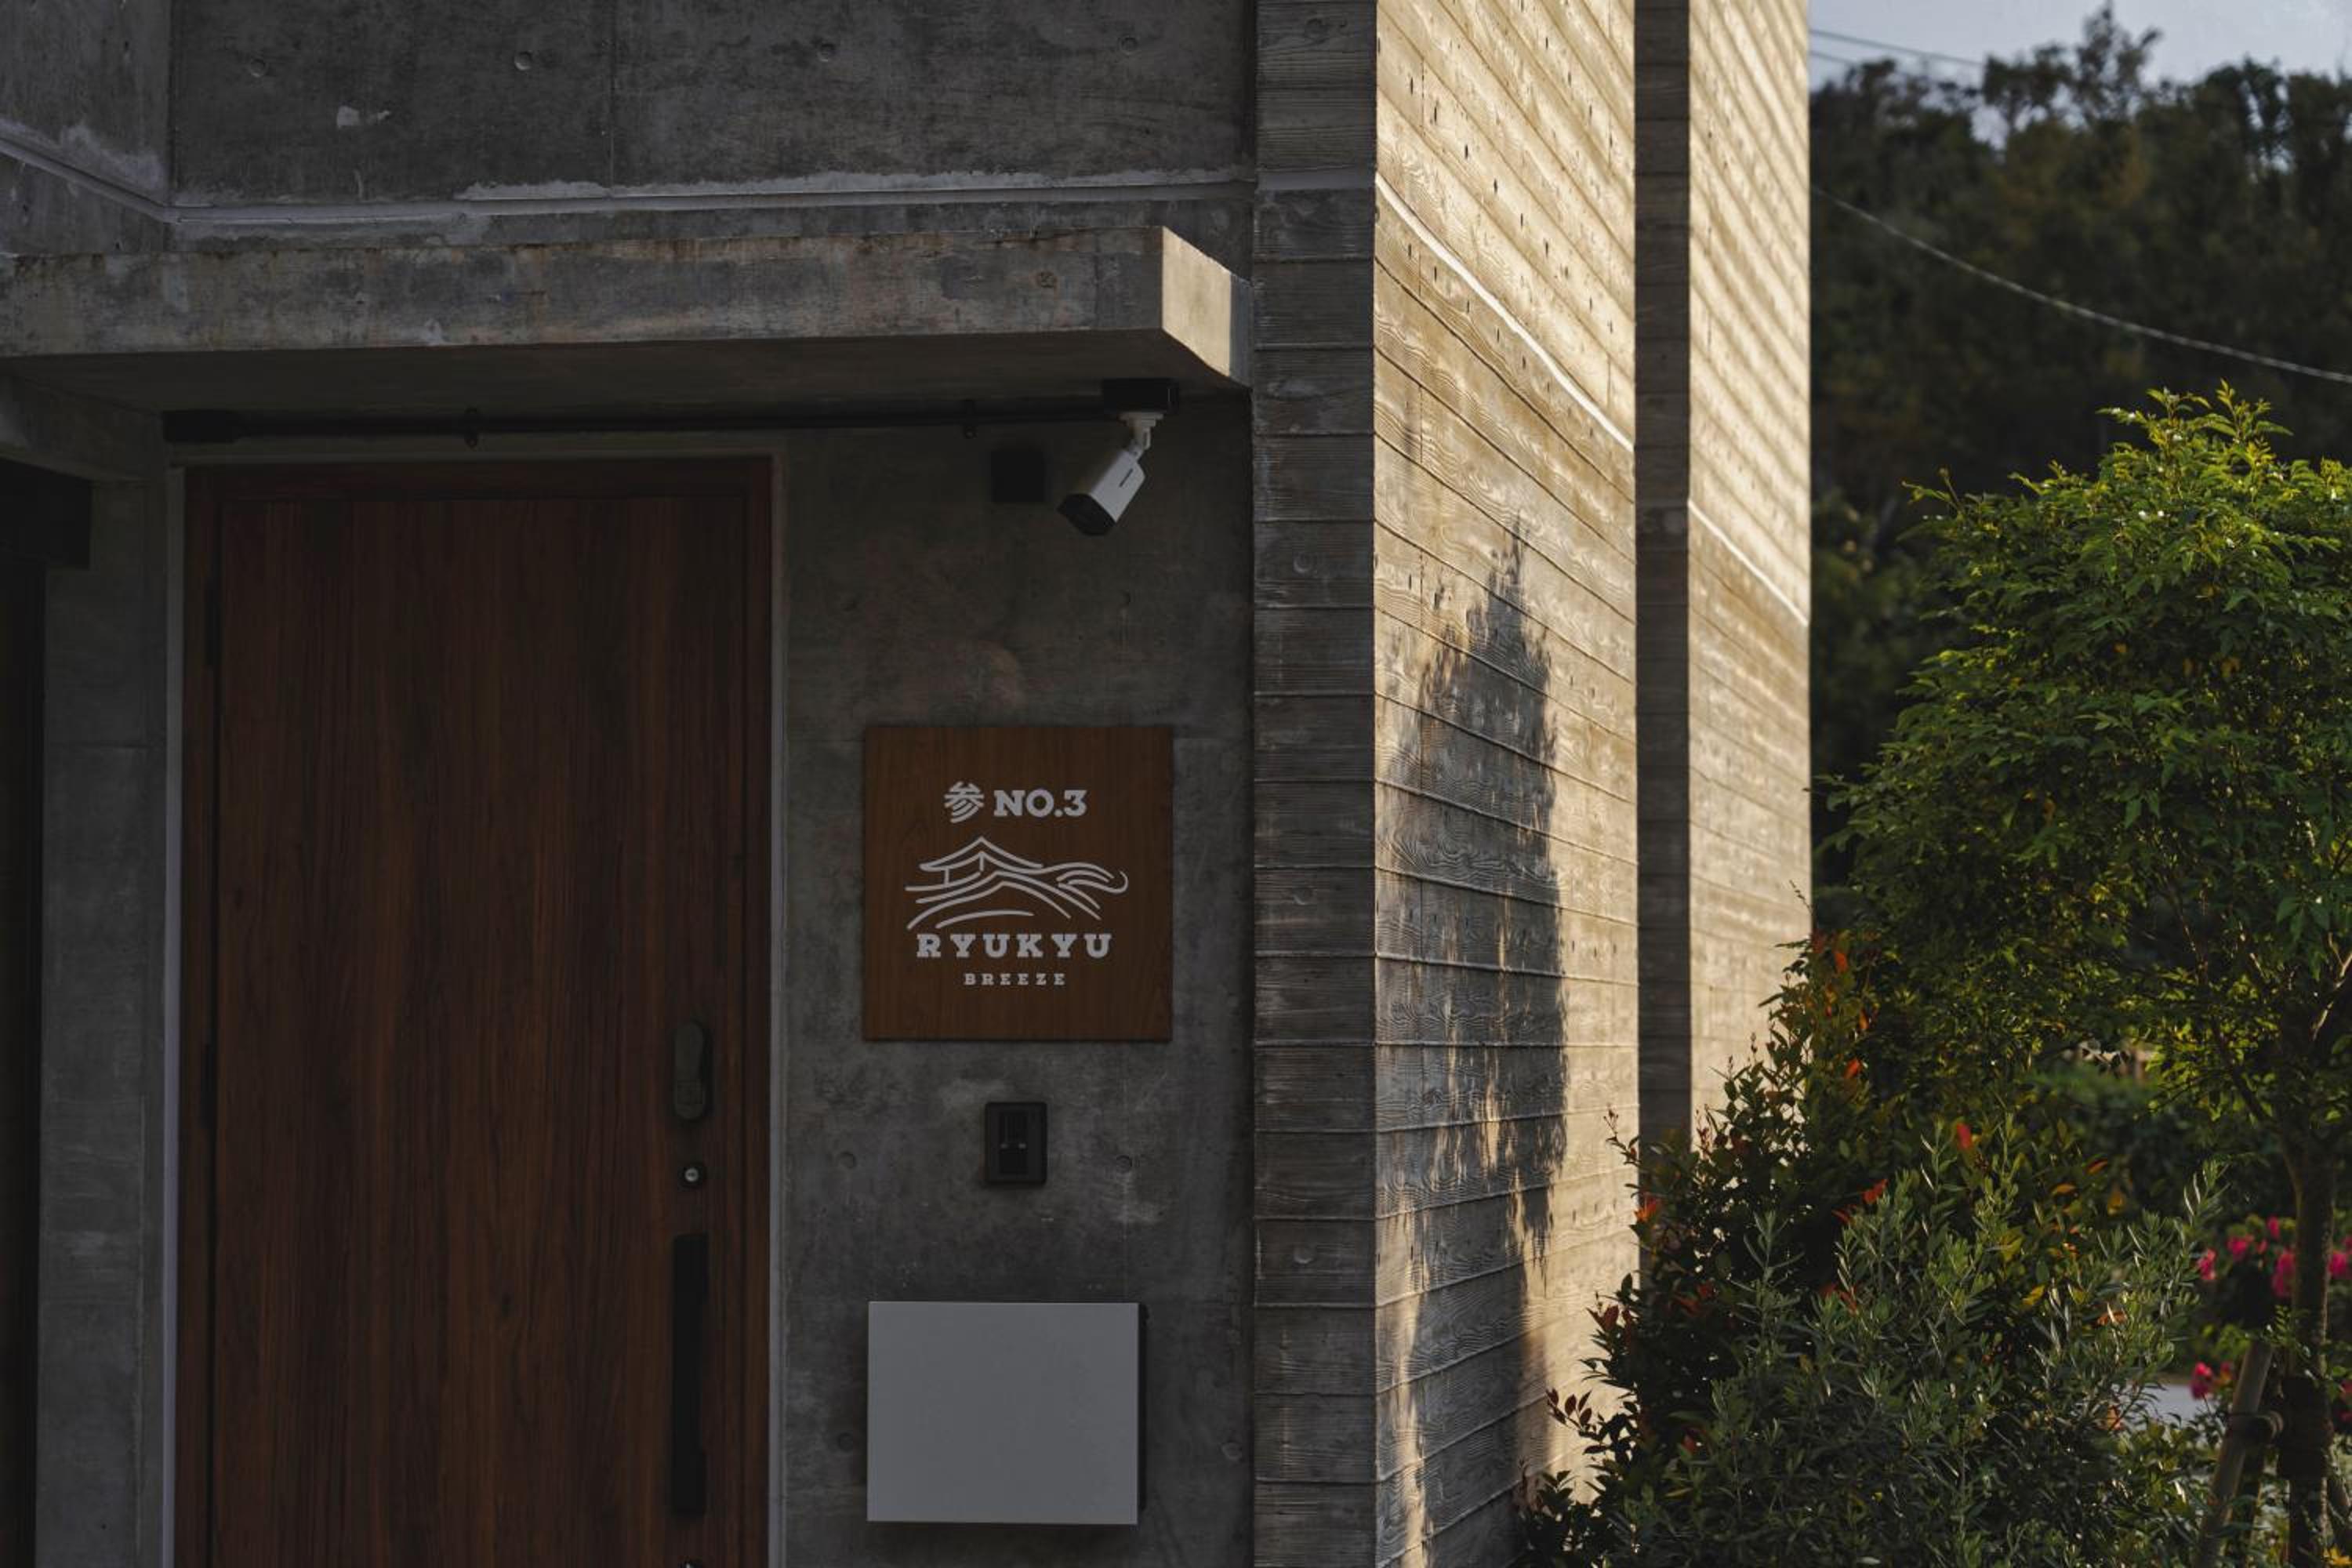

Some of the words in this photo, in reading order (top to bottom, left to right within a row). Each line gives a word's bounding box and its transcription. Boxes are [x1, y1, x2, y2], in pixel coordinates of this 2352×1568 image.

[993, 789, 1087, 818] NO.3
[916, 933, 1112, 959] RYUKYU
[964, 973, 1065, 985] BREEZE
